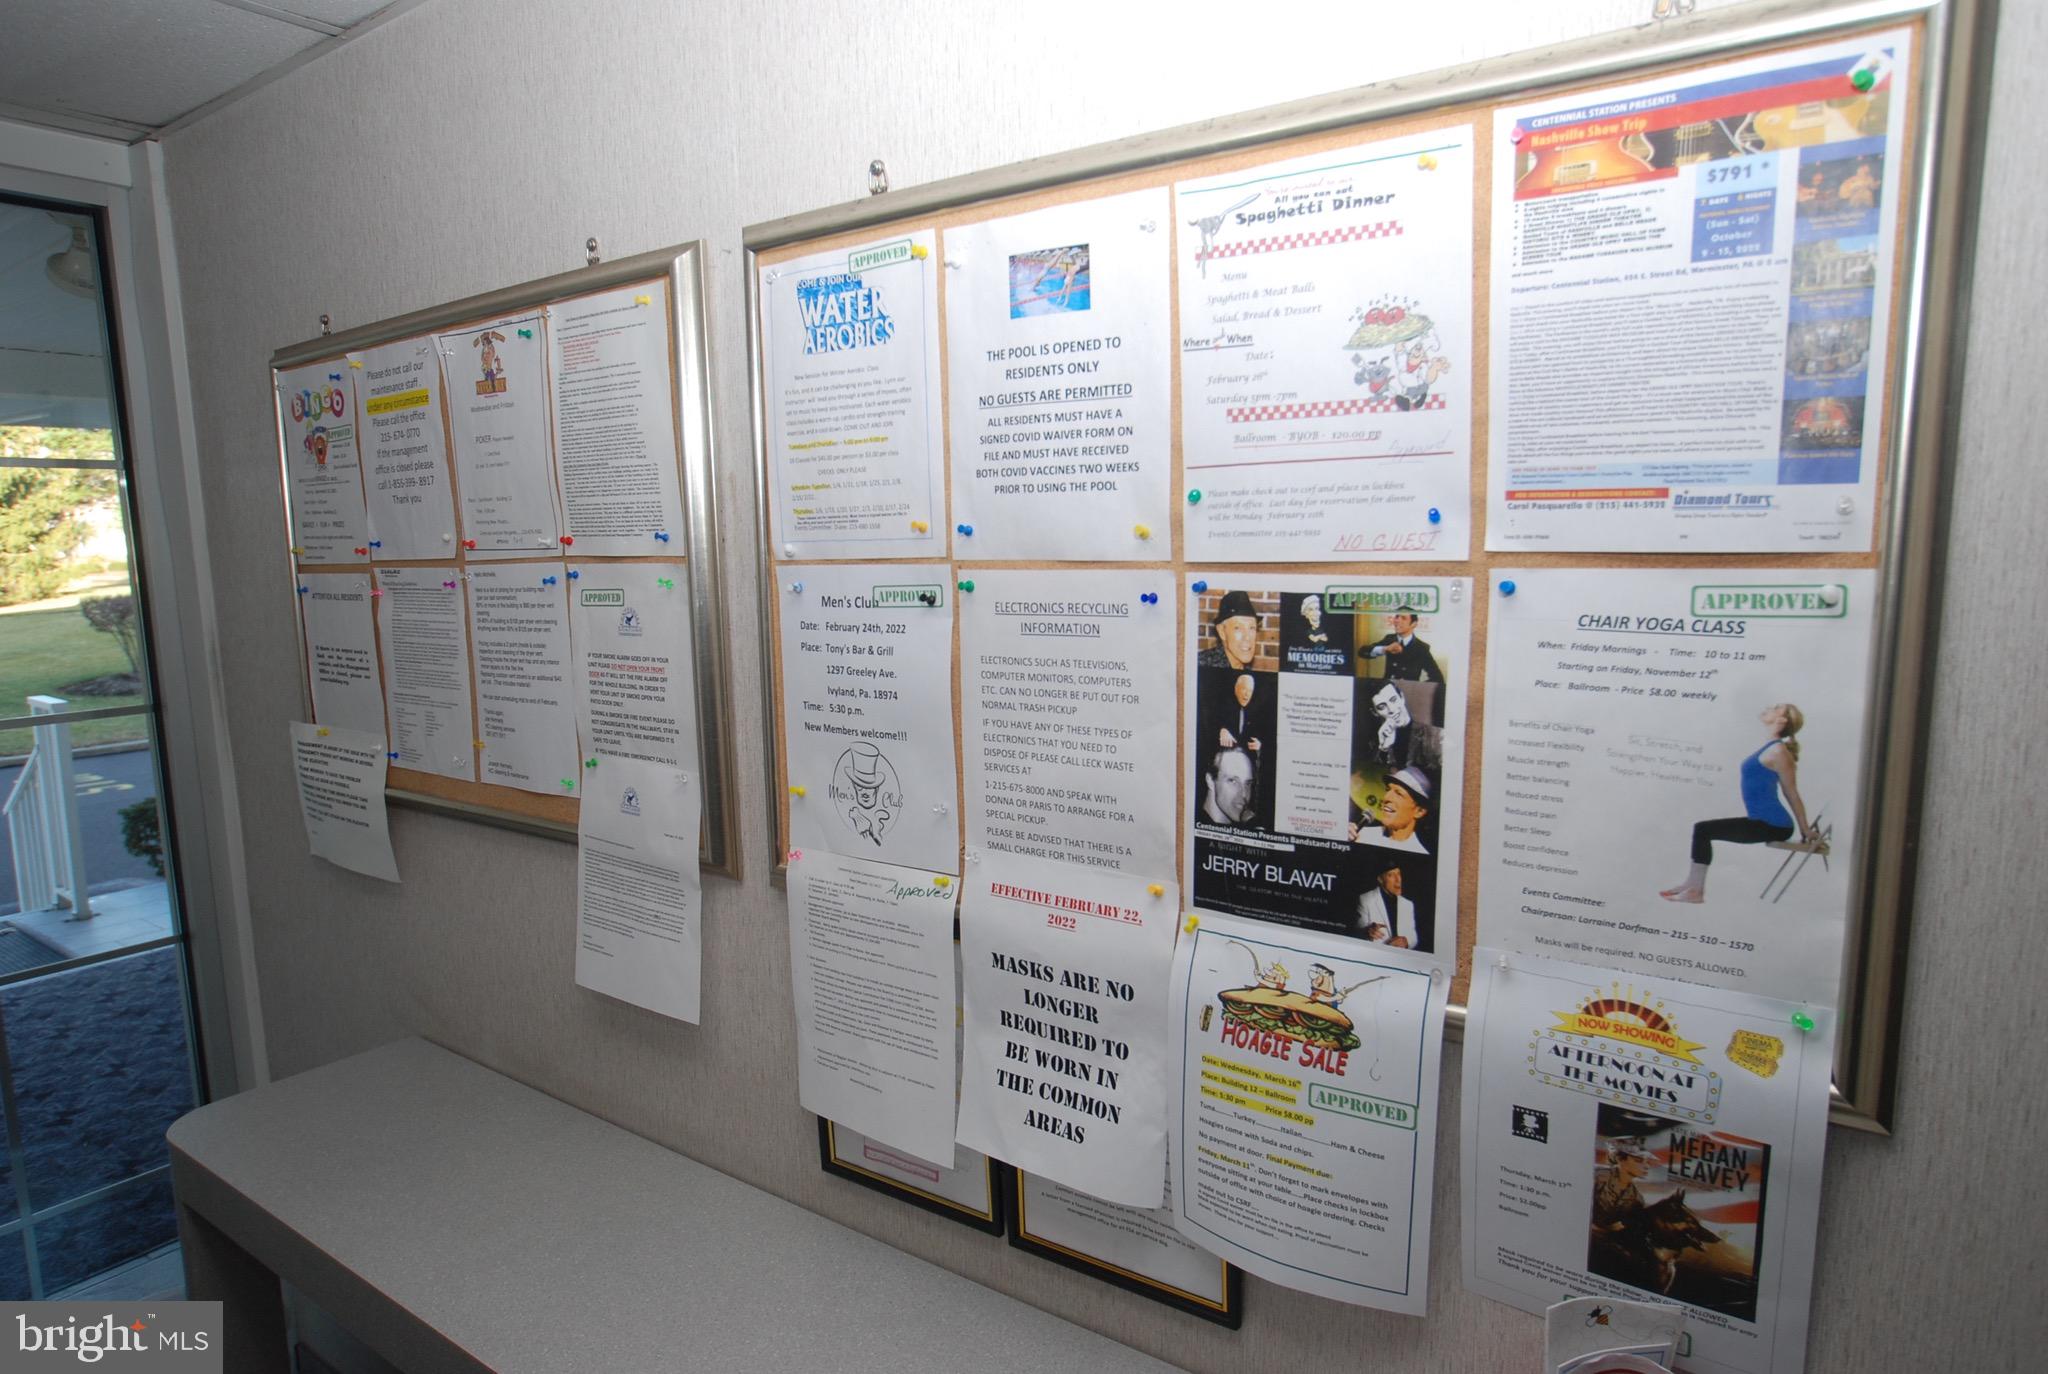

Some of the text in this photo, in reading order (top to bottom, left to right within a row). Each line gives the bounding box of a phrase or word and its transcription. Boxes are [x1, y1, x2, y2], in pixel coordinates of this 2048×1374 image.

[1532, 93, 1677, 128] CENTENNIAL STATION PRESENTS
[1531, 117, 1647, 147] Nashville Show Trip
[1707, 164, 1753, 183] $791
[1275, 195, 1288, 204] All
[1292, 193, 1310, 202] you
[1336, 185, 1353, 195] eat
[1235, 193, 1395, 227] Spaghetti Dinner
[1711, 230, 1752, 244] October
[854, 246, 907, 268] APPROVED
[797, 279, 818, 289] COME
[827, 274, 844, 286] JOIN
[846, 273, 862, 284] OUR
[1221, 271, 1248, 282] Menu
[799, 287, 892, 327] WATER
[804, 318, 895, 355] AEROBICS
[1227, 334, 1253, 344] When
[987, 336, 1121, 362] THE POOL IS OPENED TO
[367, 363, 424, 379] Please do not call our
[1005, 360, 1099, 380] RESIDENTS ONLY
[371, 383, 404, 395] maintenance
[979, 383, 1132, 406] NO GUESTS ARE PERMITTED
[292, 385, 345, 423] BINGO
[372, 412, 426, 427] Please call the office
[988, 408, 1123, 427] ALL RESIDENTS MUST HAVE A
[392, 494, 422, 505] Thank you
[1674, 493, 1774, 507] Diamond Tours
[1335, 529, 1441, 550] NO GUEST
[584, 592, 621, 603] APPROVED
[821, 595, 851, 608] Men's
[1333, 591, 1430, 608] APPROVED
[995, 602, 1129, 615] ELECTRONICS RECYCLING
[800, 621, 906, 634] Date: February 24th, 2022
[1021, 622, 1101, 635] INFORMATION
[1578, 614, 1746, 635] CHAIR YOGA CLASS
[800, 642, 894, 657] Place: Tony's Bar & Grill
[1288, 652, 1345, 665] MEMORIES
[1537, 641, 1646, 657] When: Friday Mornings
[826, 665, 897, 680] 1297 Greeley Ave.
[980, 656, 1128, 671] ELECTRONICS SUCH AS TELEVISIONS,
[827, 686, 898, 701] Ivyland, Pa. 18974
[803, 701, 865, 716] Time: 5:30 p.m.
[804, 722, 908, 742] New Members welcome!!!
[985, 781, 1045, 796] 1-215-675-8000
[1196, 821, 1351, 852] Centennial Station Presents Bandstand Days
[1203, 854, 1336, 892] JERRY BLAVAT
[991, 882, 1051, 905] EFFECTIVE
[1054, 895, 1120, 918] FEBRUARY
[1047, 914, 1077, 929] 2022
[1639, 951, 1747, 978] NO GUESTS ALLOWED.
[991, 952, 1135, 1002] MASKS ARE NO
[1024, 988, 1100, 1024] LONGER
[1000, 1010, 1129, 1060] REQUIRED TO
[1578, 1017, 1676, 1049] NOW SHOWING
[1221, 1017, 1349, 1076] HOAGIE SALE
[1005, 1040, 1119, 1090] BE WORN IN
[1201, 1056, 1287, 1084] Date: Wednesday, March
[1548, 1044, 1696, 1089] AFTERNOON AT
[1221, 1075, 1258, 1093] Building 12
[1563, 1064, 1678, 1103] THE MOVIES
[997, 1069, 1122, 1124] THE COMMON
[1316, 1089, 1408, 1122] APPROVED
[1265, 1105, 1314, 1126] Price $8.00 pp
[1024, 1109, 1085, 1144] AREAS
[1670, 1132, 1748, 1171] MEGAN
[1668, 1157, 1749, 1192] LEAVEY
